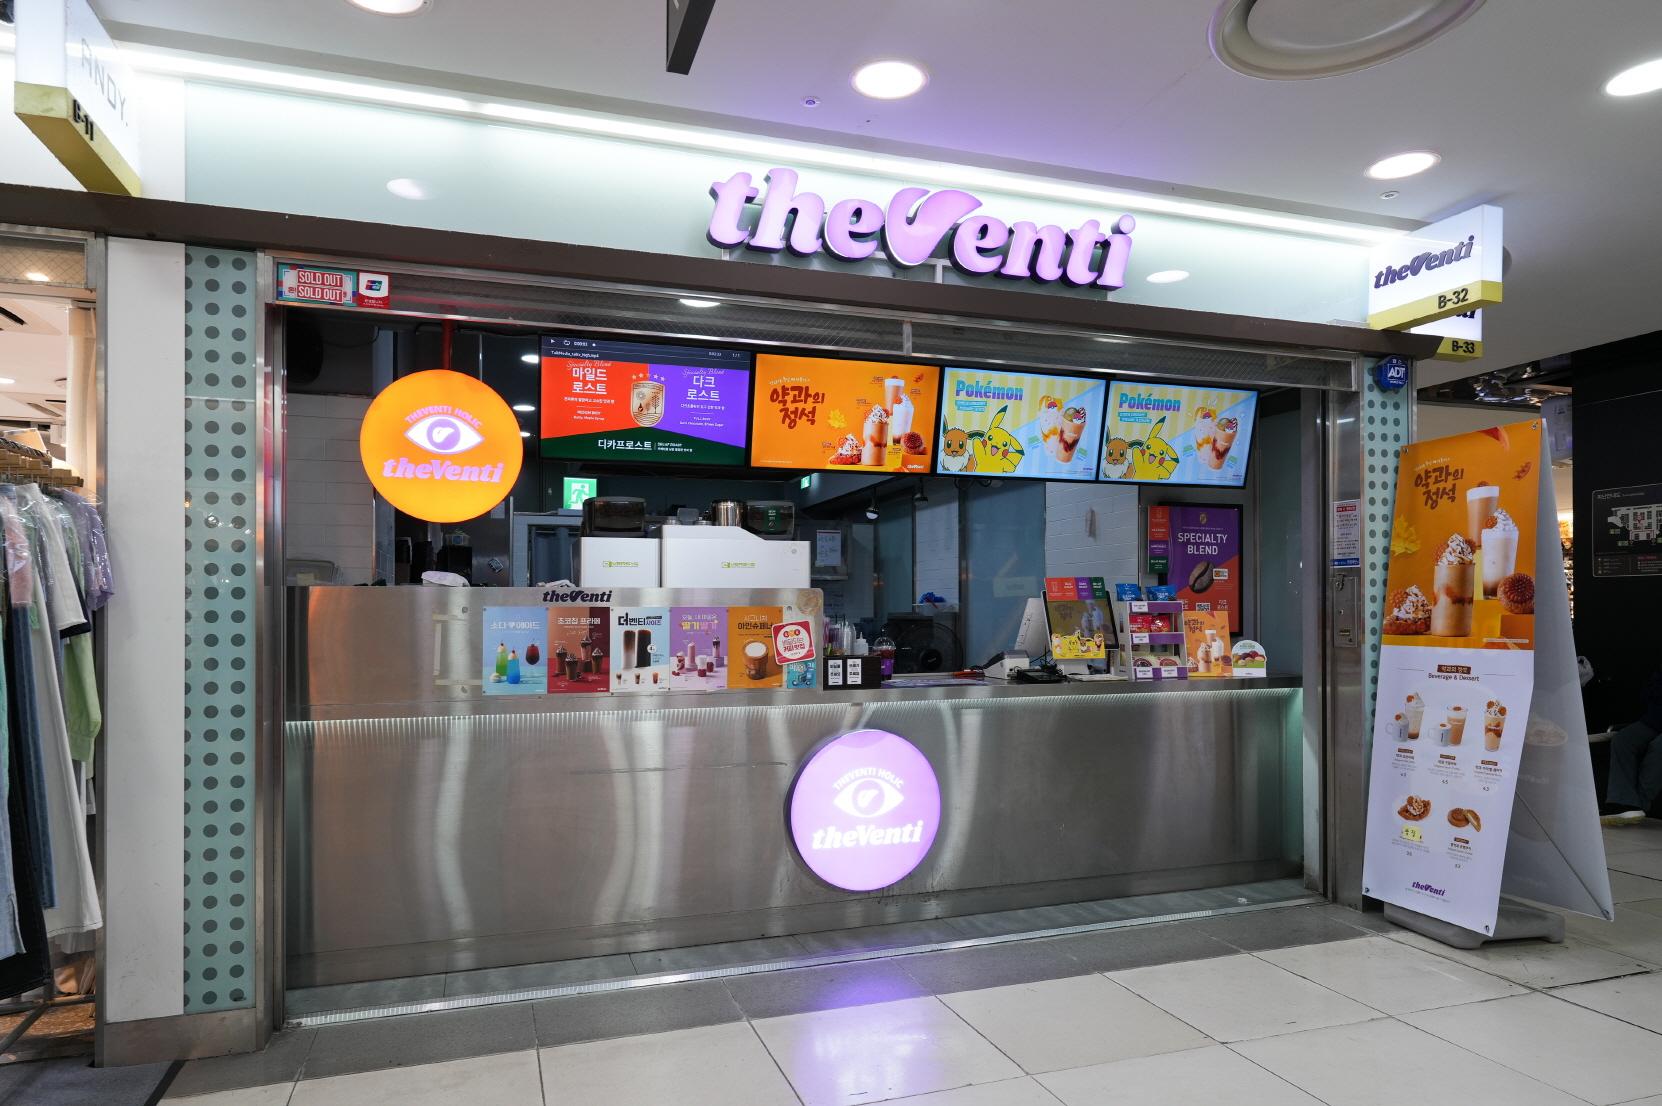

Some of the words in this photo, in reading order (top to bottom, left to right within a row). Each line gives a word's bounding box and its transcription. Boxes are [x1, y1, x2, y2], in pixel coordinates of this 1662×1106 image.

[706, 168, 1136, 290] theVenti
[1373, 235, 1475, 289] theVenti
[299, 271, 321, 284] SOLD
[324, 274, 341, 286] OUT
[298, 286, 321, 299] SOLD
[323, 290, 341, 301] OUT
[1437, 287, 1469, 309] B-32
[1451, 340, 1475, 354] B-33
[572, 367, 608, 381] 마일드
[1387, 367, 1405, 378] ADT
[572, 381, 608, 395] 로스트
[693, 375, 716, 388] 다크
[686, 388, 721, 402] 로스트
[769, 384, 825, 406] 약과의
[955, 379, 1024, 401] Pokémon
[1119, 393, 1181, 411] Pokémon
[405, 405, 452, 424] THEVENTI
[779, 405, 817, 430] 정석
[597, 438, 653, 451] 디카프로스트
[382, 457, 505, 483] theVenti
[1414, 464, 1464, 488] 약과의
[1423, 483, 1457, 509] 정석
[1177, 531, 1228, 544] SPECIALTY
[1187, 544, 1219, 556] BLEND
[542, 589, 613, 603] theVenti
[617, 611, 646, 626] 더벤티
[1428, 672, 1453, 681] Beverage
[1458, 674, 1480, 682] Dessert
[811, 820, 924, 850] theVenti
[1411, 881, 1446, 897] theVenti
